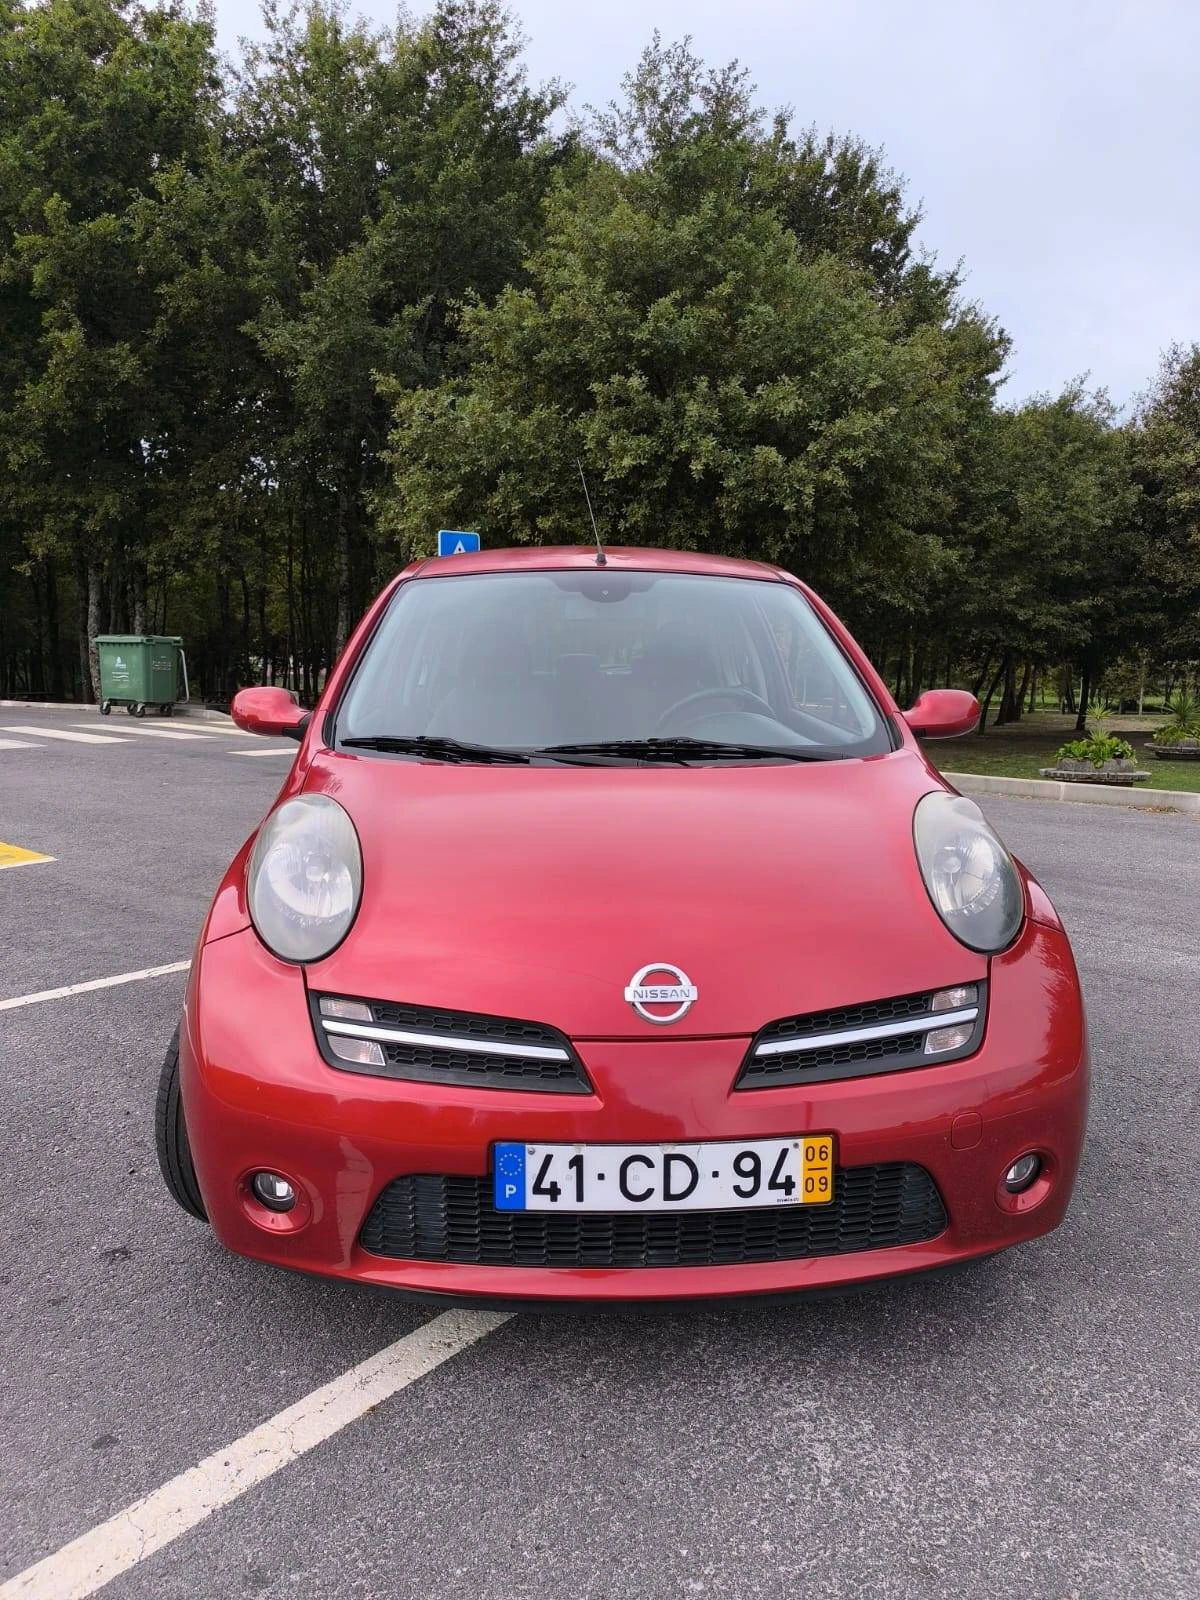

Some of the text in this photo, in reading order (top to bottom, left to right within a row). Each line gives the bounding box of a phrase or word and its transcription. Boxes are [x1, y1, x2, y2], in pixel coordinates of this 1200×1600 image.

[633, 989, 690, 999] NISSAN
[805, 1145, 829, 1162] 06
[505, 1184, 517, 1198] P
[805, 1176, 828, 1193] 09
